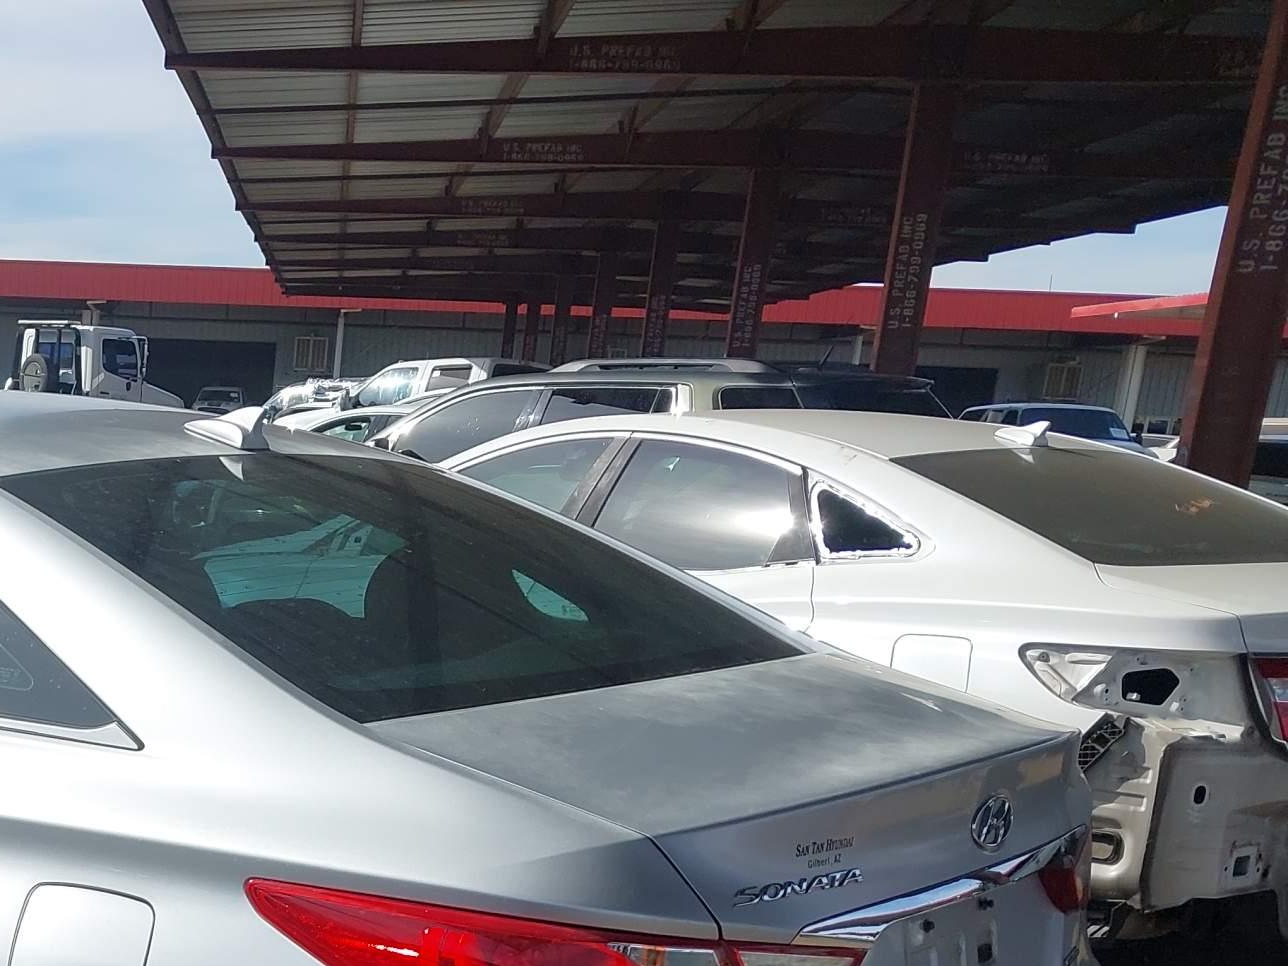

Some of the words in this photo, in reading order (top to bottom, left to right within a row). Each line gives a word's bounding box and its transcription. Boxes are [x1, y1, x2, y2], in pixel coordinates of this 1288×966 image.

[1249, 132, 1286, 219] PREFAB
[892, 244, 911, 298] PREFAB
[901, 213, 929, 328] 1-866-799-0969
[833, 853, 842, 864] AZ
[733, 867, 865, 908] SONATA
